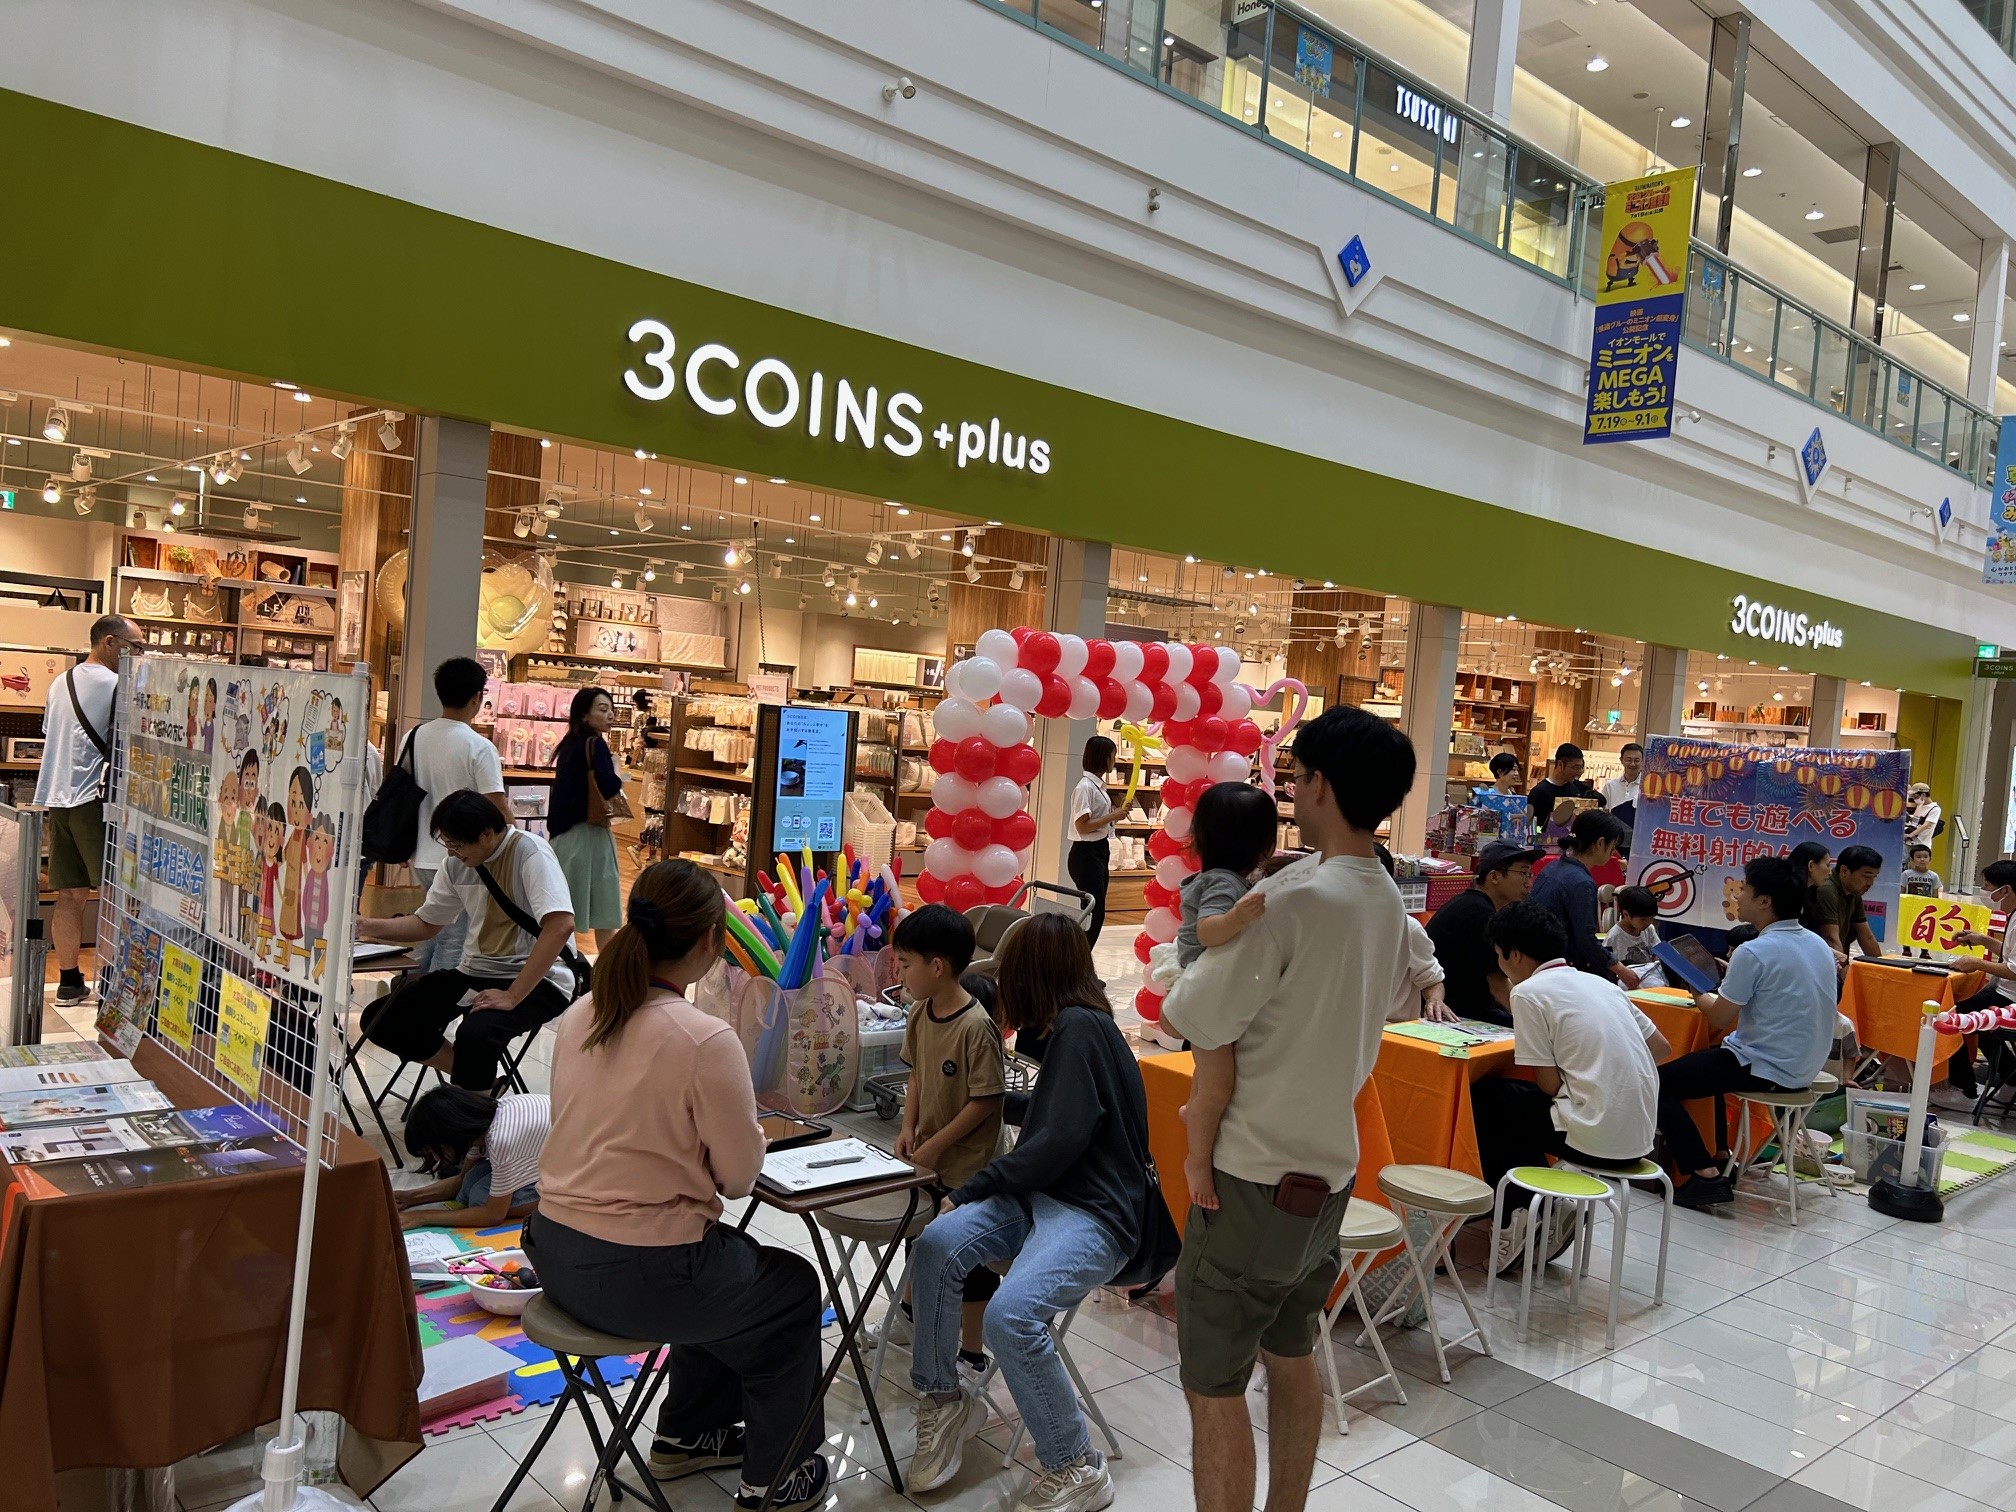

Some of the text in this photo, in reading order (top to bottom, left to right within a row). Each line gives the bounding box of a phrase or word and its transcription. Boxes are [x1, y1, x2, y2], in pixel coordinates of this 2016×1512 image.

[1608, 333, 1666, 347] イオンモールで
[1597, 343, 1674, 368] ミニオンを
[1598, 365, 1663, 390] MEGA
[1669, 794, 1857, 839] 誰でも遊べる
[139, 832, 205, 898] 無料相談会
